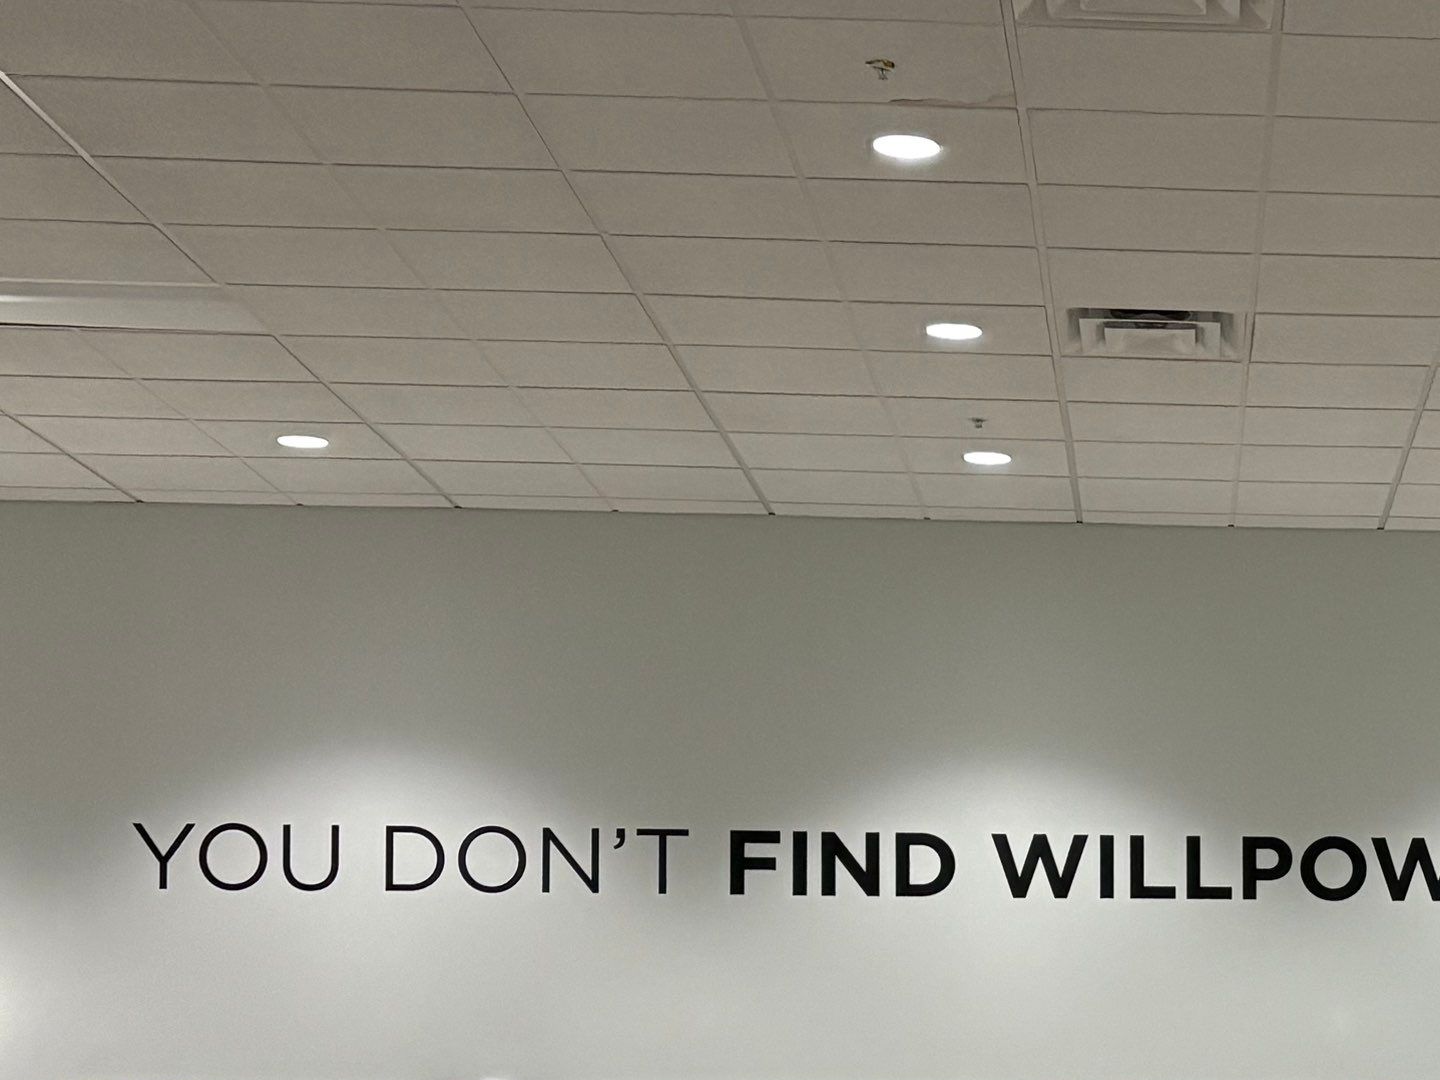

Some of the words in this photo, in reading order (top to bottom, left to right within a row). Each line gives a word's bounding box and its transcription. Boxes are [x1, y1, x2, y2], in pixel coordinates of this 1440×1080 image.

[131, 822, 341, 892] YOU
[384, 825, 691, 895] DON’T
[729, 829, 956, 897] FIND
